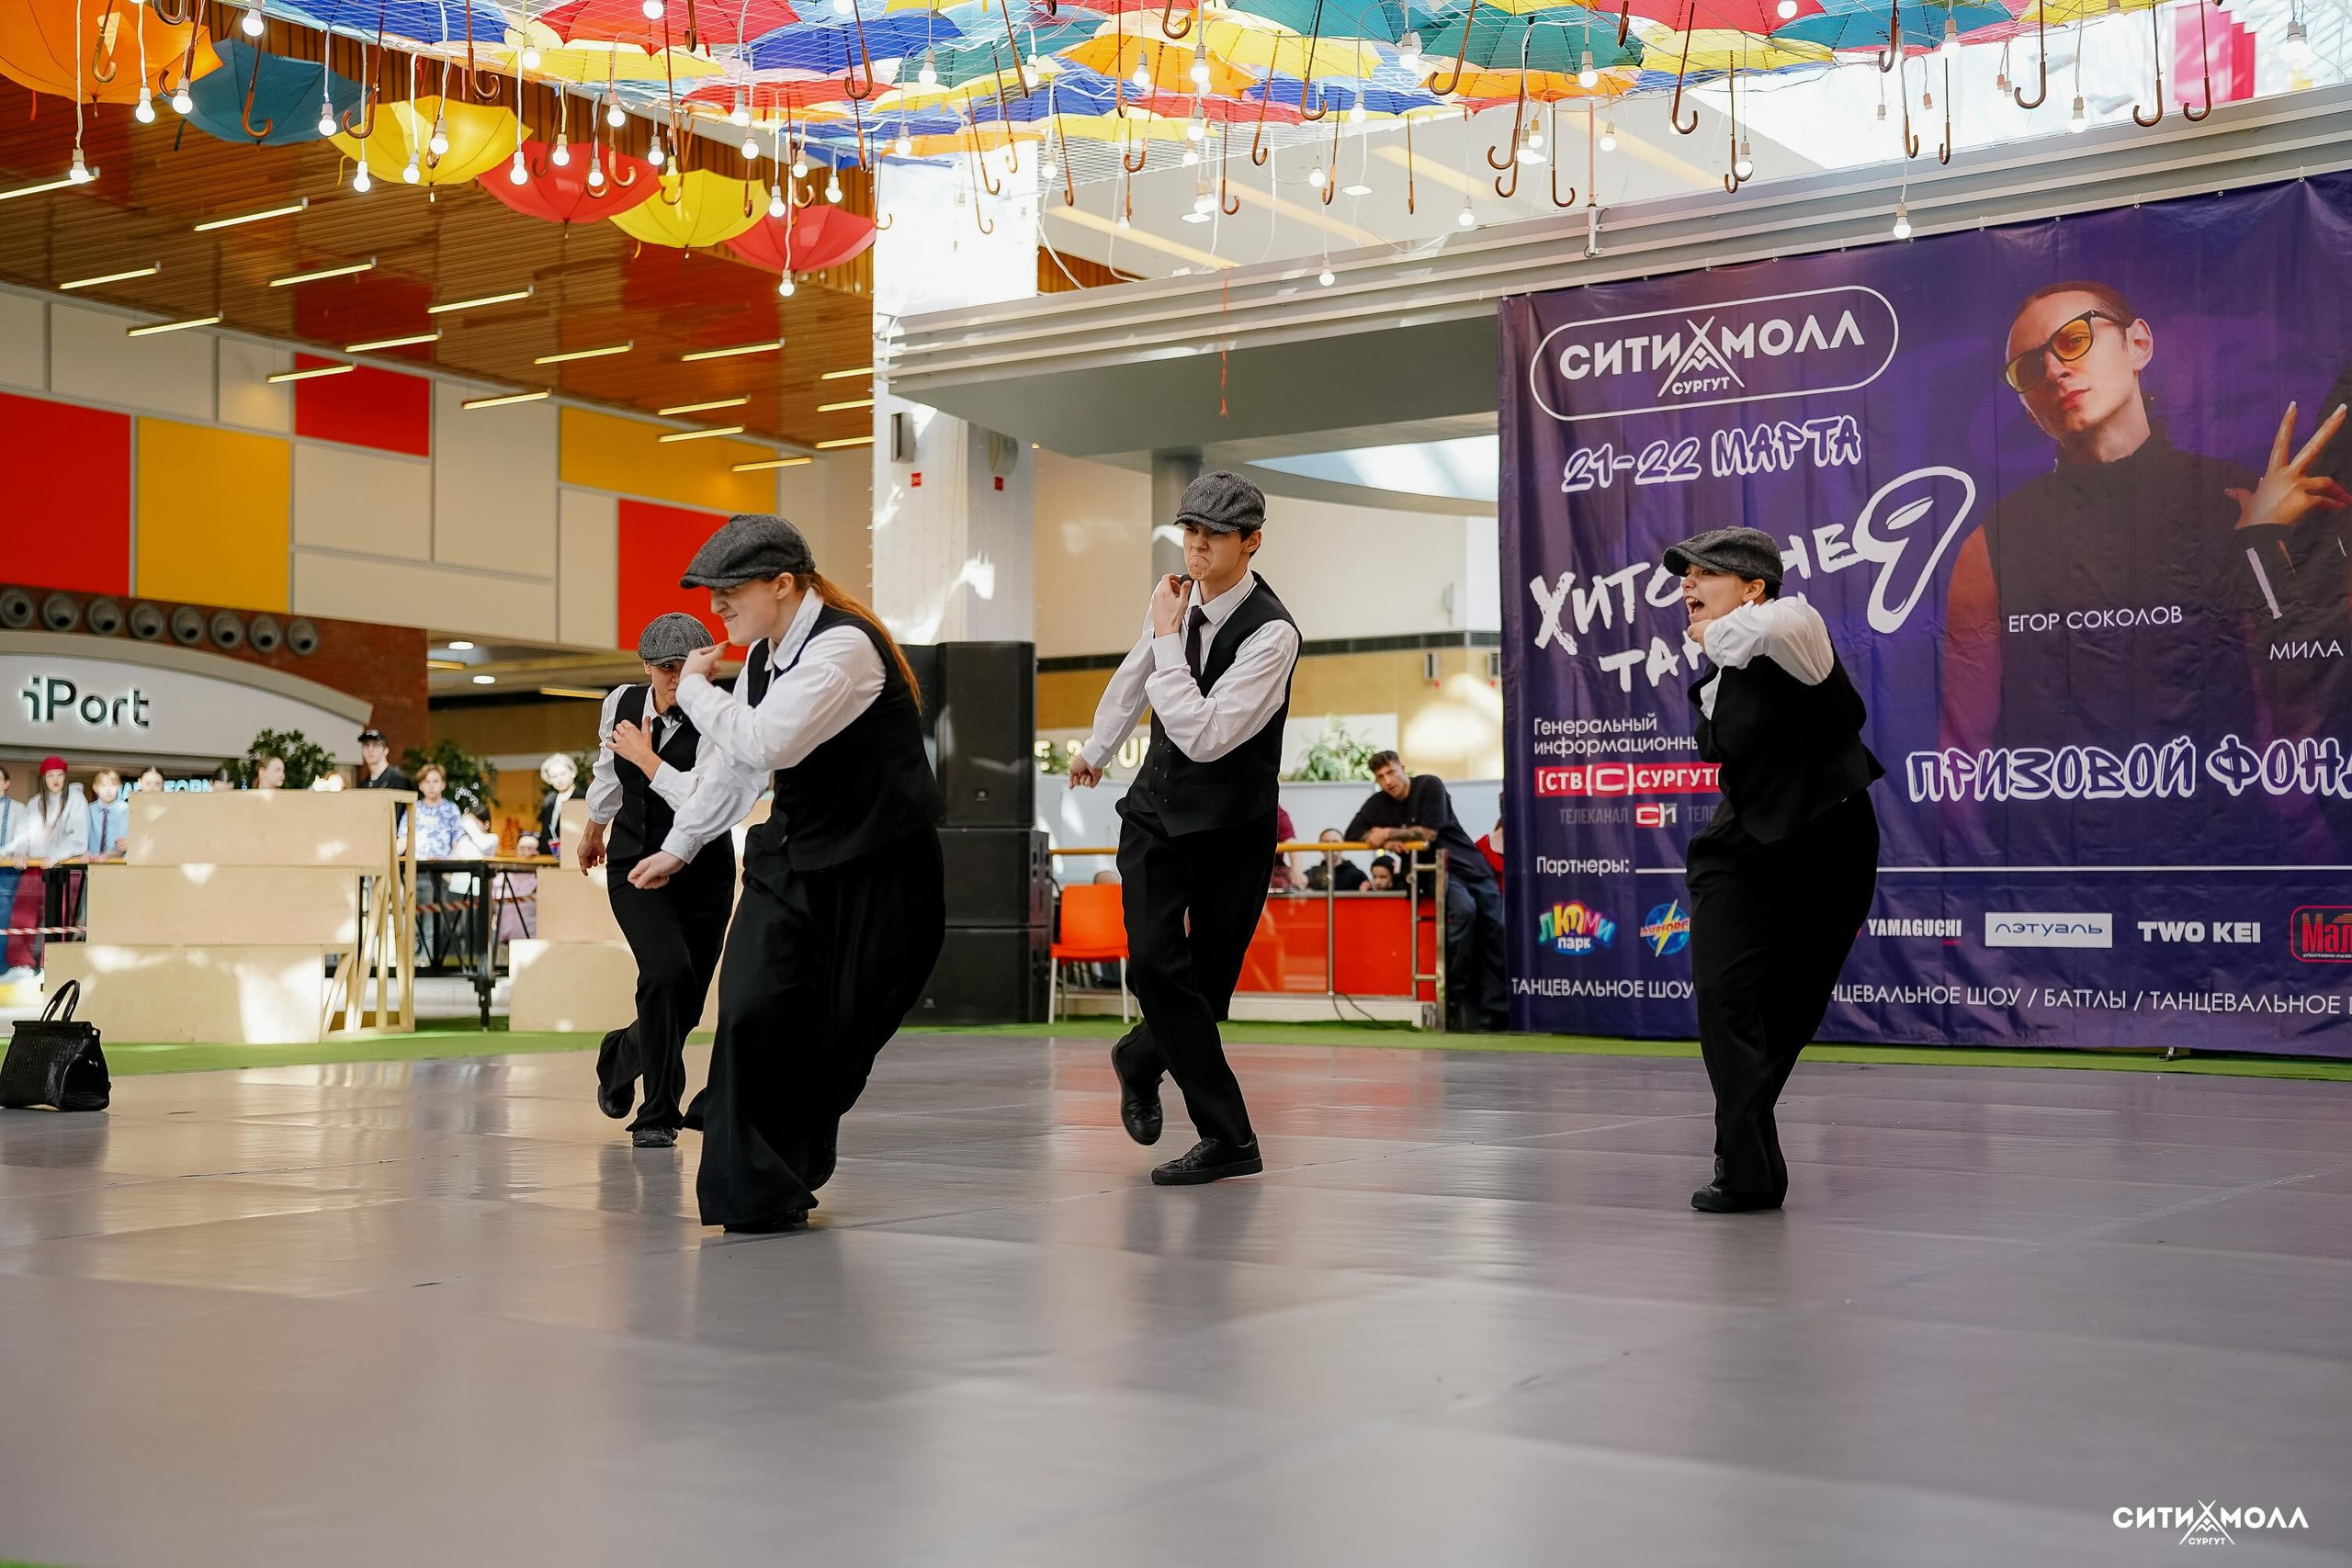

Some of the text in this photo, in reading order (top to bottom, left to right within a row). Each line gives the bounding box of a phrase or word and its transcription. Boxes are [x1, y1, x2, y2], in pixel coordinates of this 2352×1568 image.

[1560, 310, 1865, 380] СИТИ МОЛЛ
[1671, 377, 1730, 396] СУРГУТ
[1561, 414, 1862, 493] 21-22 МАРТА
[2008, 605, 2183, 633] ЕГОР СОКОЛОВ
[2269, 639, 2344, 660] МИЛА
[18, 675, 149, 728] iPort
[1533, 713, 1657, 738] Генеральный
[1905, 735, 2196, 803] ПРИЗОВОЙ
[1559, 807, 1629, 825] ТЕЛЕКАНАЛ
[1536, 856, 1630, 877] Партнеры:
[1538, 899, 1616, 944] ЛЮМИ
[1868, 919, 1962, 937] YAMAGUCHI
[2137, 921, 2261, 943] TWO KEI
[1558, 937, 1591, 952] парк
[1511, 977, 1644, 998] ТАНЦЕВАЛЬНОЕ
[1648, 980, 1694, 999] ШОУ
[1967, 987, 2021, 1006] ШОУ
[2044, 988, 2126, 1010] БАТТЛЫ
[2149, 990, 2341, 1014] ТАНЦЕВАЛЬНОЕ
